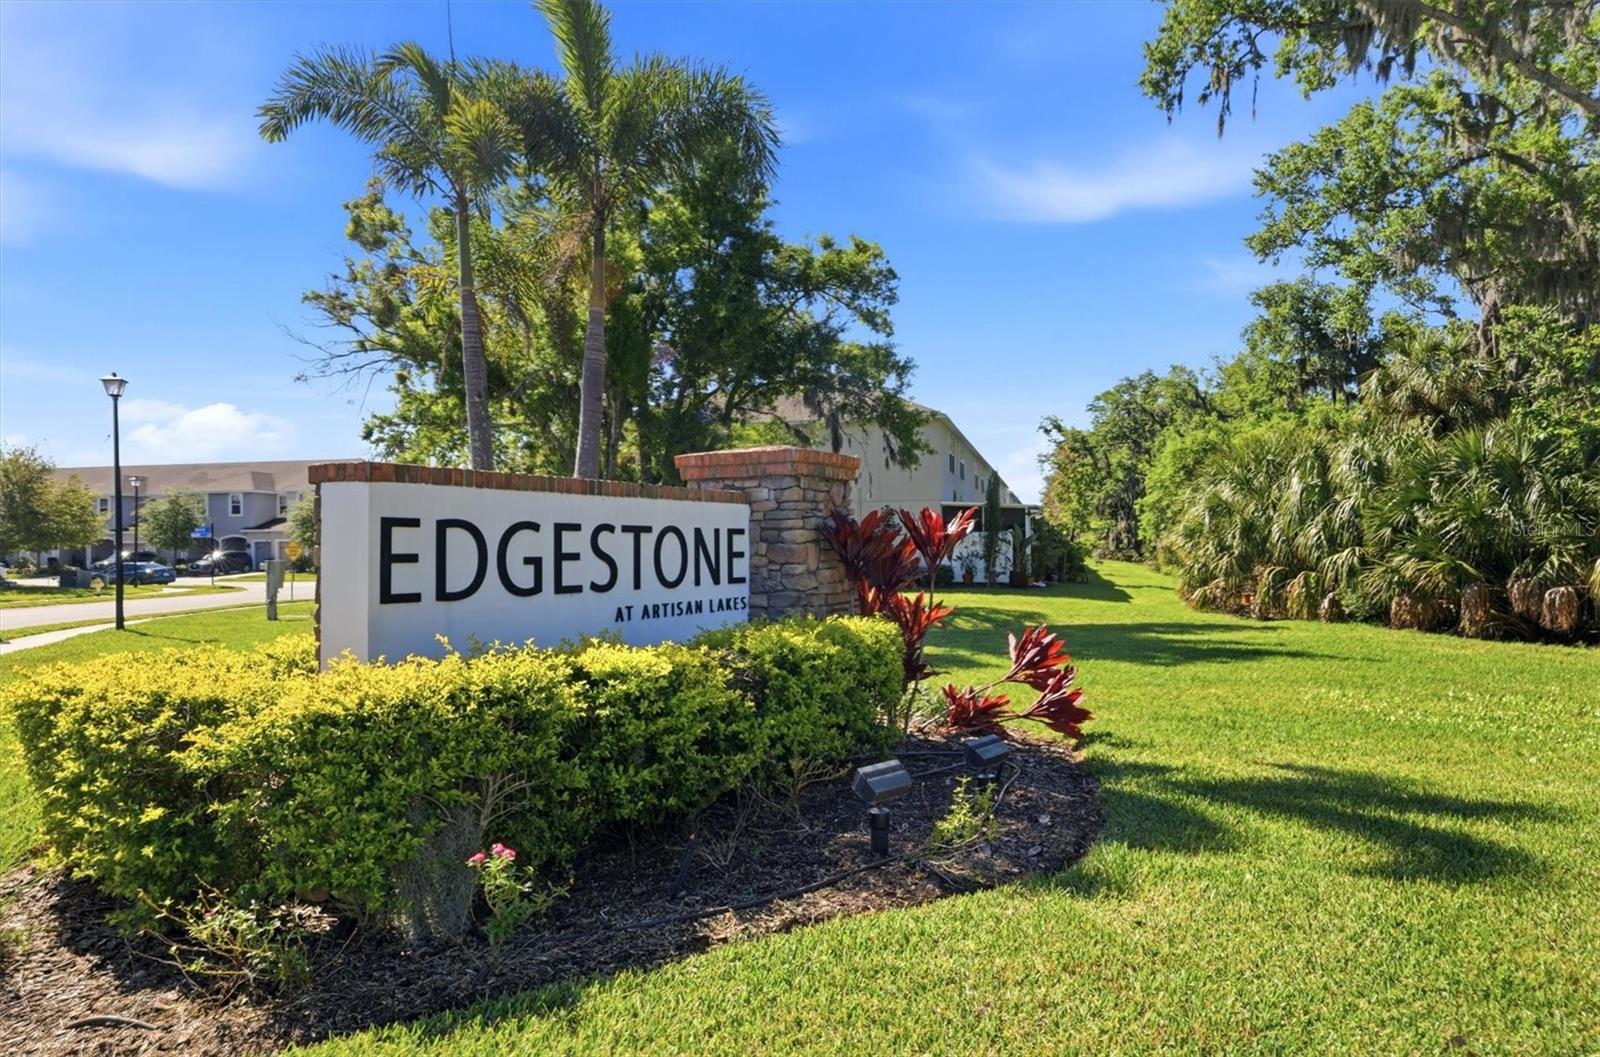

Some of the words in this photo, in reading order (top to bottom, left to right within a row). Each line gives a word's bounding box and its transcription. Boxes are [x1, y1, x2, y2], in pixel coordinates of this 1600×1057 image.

[379, 516, 747, 605] EDGESTONE
[615, 604, 633, 623] AT
[641, 600, 703, 619] ARTISAN
[709, 597, 748, 612] LAKES
